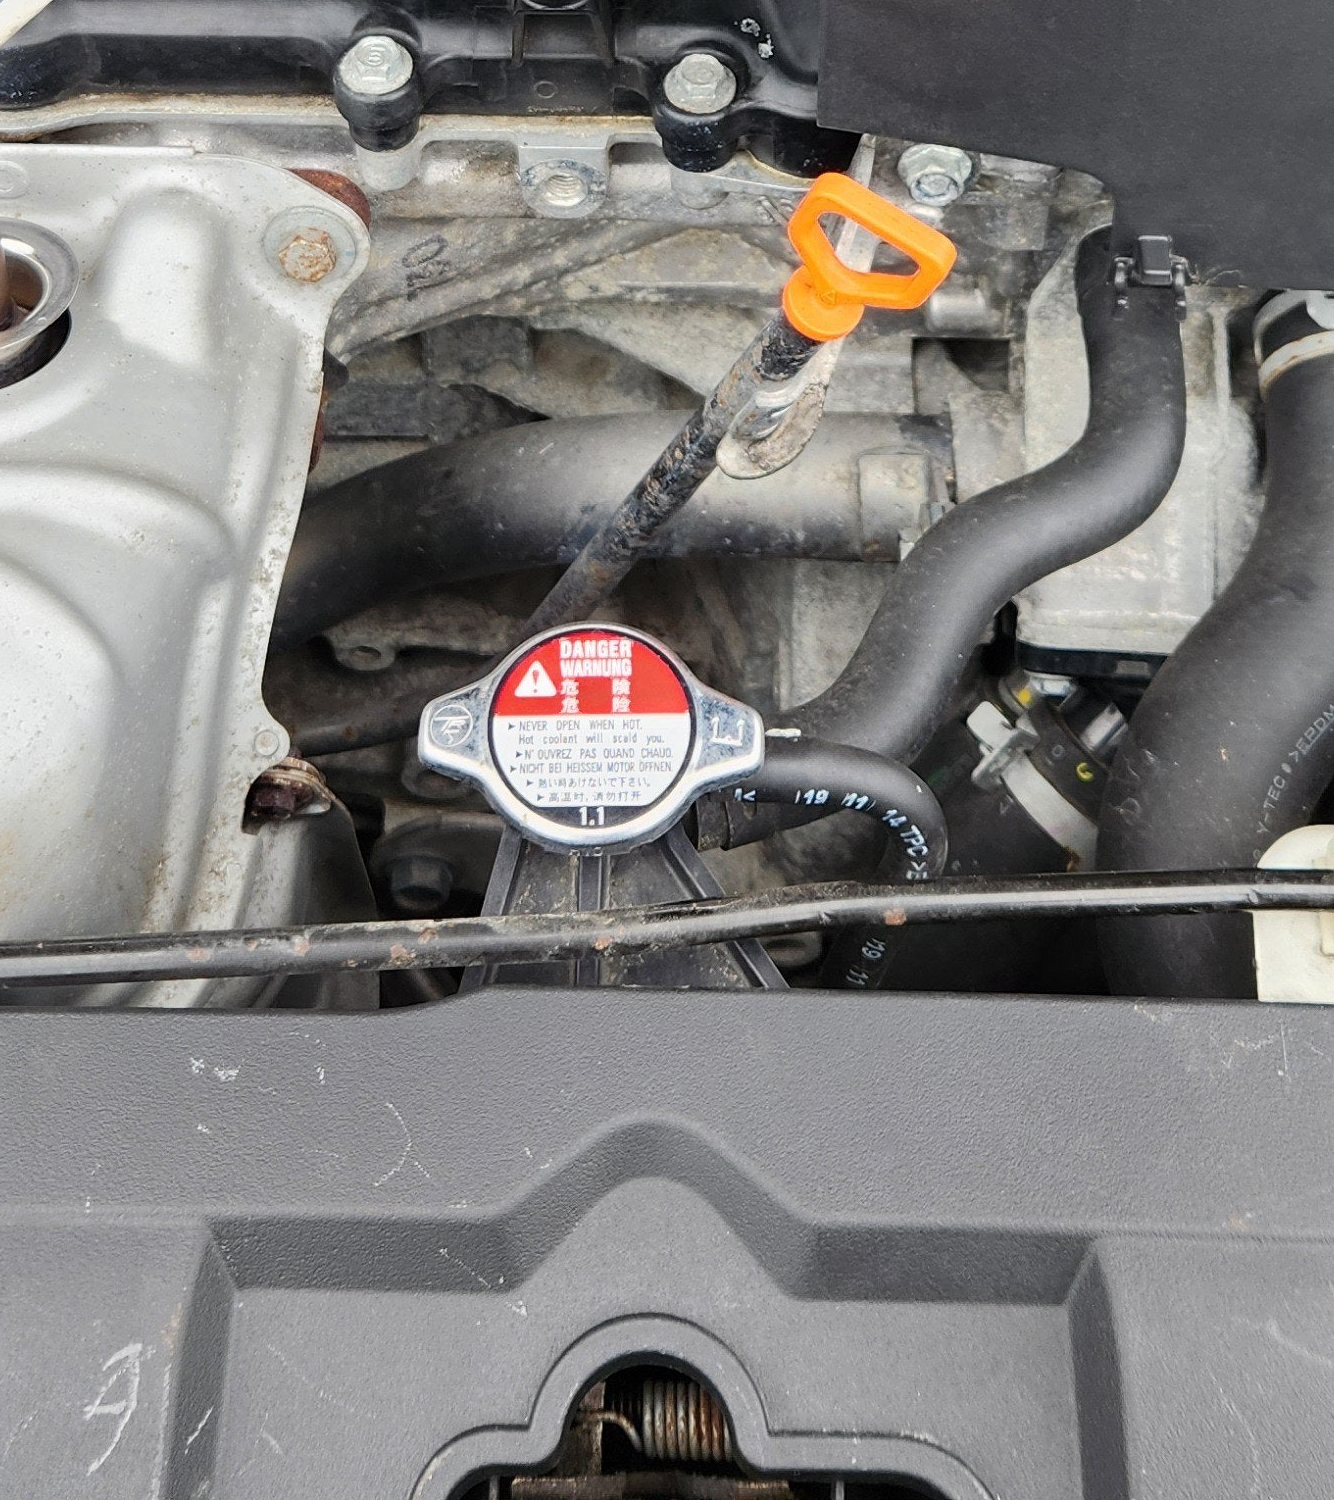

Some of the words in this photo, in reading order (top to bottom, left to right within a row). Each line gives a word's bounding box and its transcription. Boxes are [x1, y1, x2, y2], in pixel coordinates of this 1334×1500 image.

[560, 639, 632, 658] DANGER
[560, 658, 633, 677] WARNUNG
[519, 721, 547, 731] NEVER
[556, 720, 580, 731] OPEN
[589, 719, 614, 730] WHEN
[623, 719, 642, 731] HOT.
[518, 735, 534, 745] Hot
[543, 734, 578, 744] coolant
[586, 734, 603, 744] will
[613, 733, 637, 744] scald
[646, 735, 665, 745] you.
[538, 749, 572, 759] OUVREZ
[580, 748, 596, 759] PAS
[603, 748, 635, 759] QUAND
[519, 763, 544, 774] NICHT
[548, 763, 562, 773] BEI
[567, 762, 603, 773] HEISSEM
[607, 761, 634, 772] MOTOR
[579, 806, 605, 826] 1.1
[882, 808, 908, 828] 14
[900, 824, 929, 858] TPC
